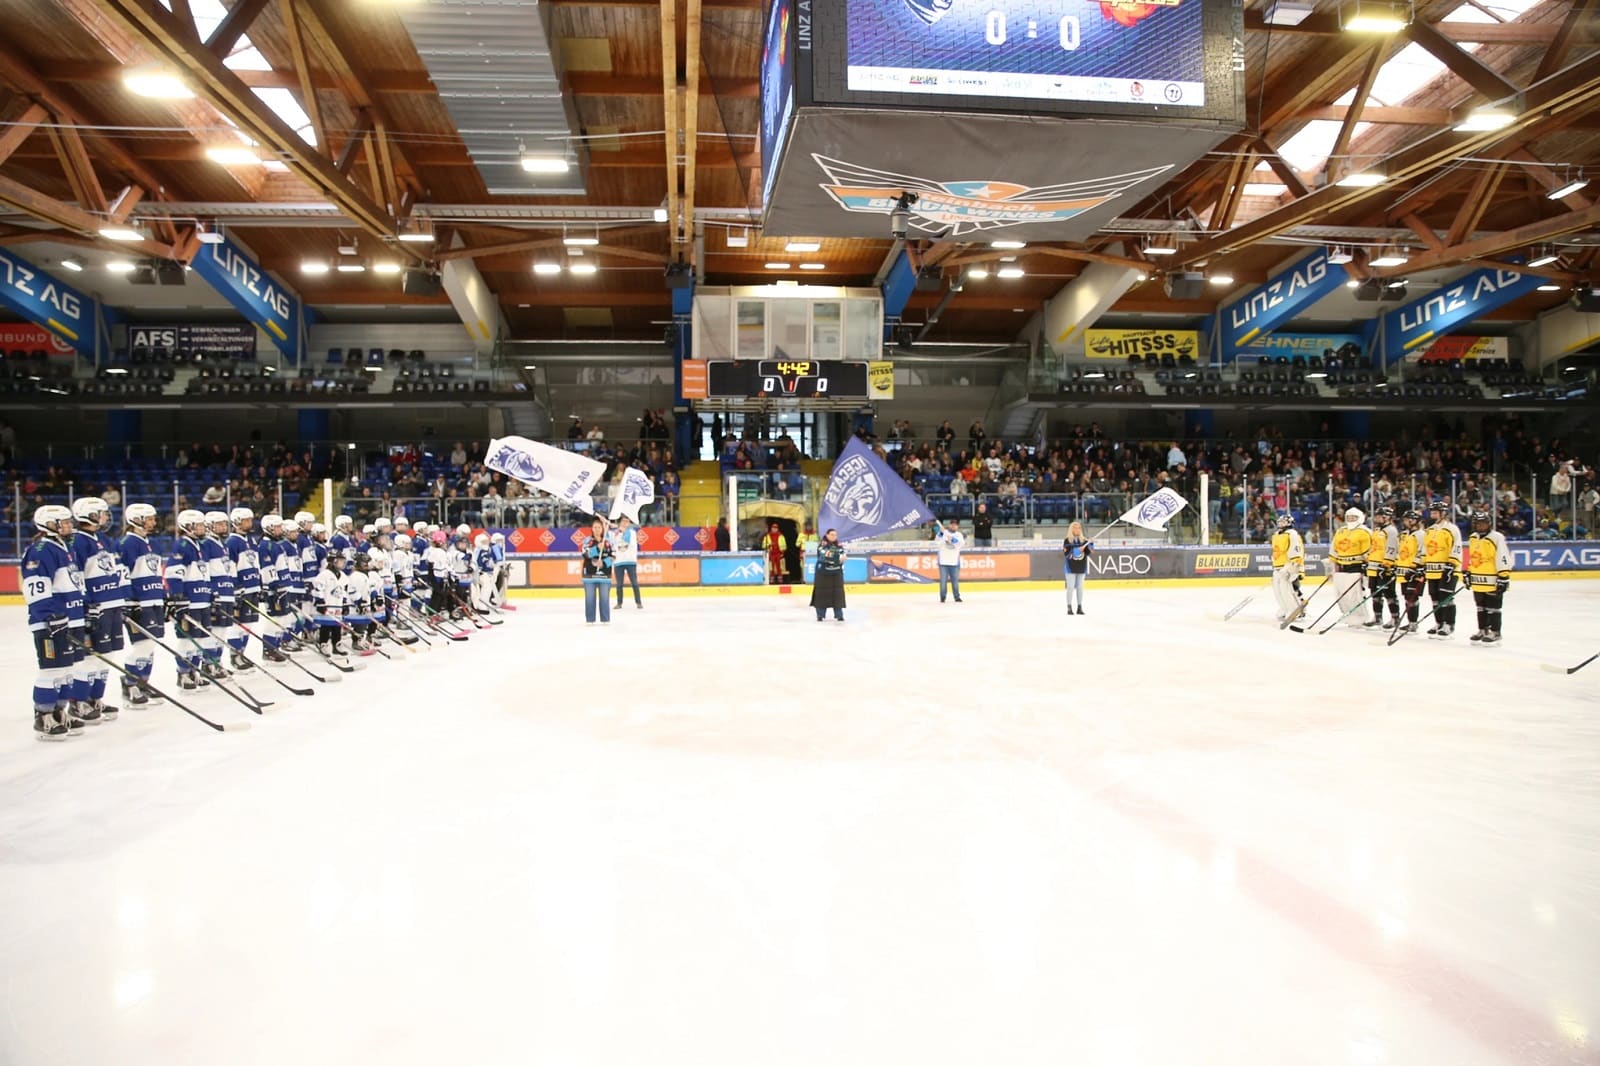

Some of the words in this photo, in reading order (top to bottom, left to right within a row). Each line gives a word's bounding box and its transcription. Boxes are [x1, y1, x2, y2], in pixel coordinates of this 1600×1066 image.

[798, 15, 811, 50] LINZ
[986, 10, 1006, 45] 0
[1061, 16, 1080, 50] 0
[966, 207, 1056, 219] WINGS
[213, 243, 261, 297] LINZ
[263, 284, 290, 320] AG
[1232, 281, 1284, 329] LINZ
[1288, 255, 1327, 297] AG
[40, 284, 81, 320] AG
[1400, 285, 1467, 332] LINZ
[1472, 269, 1520, 301] AG
[0, 333, 48, 343] BUND
[134, 331, 175, 347] AFS
[1109, 334, 1175, 356] HITSSS
[777, 362, 810, 375] 4:42
[763, 378, 774, 392] 0
[816, 378, 828, 392] 0
[922, 556, 995, 569] Stbach
[1086, 554, 1151, 575] NABO
[1501, 555, 1507, 565] 4
[1511, 549, 1552, 566] NZ
[1557, 548, 1600, 565] AG
[28, 581, 45, 596] 79
[92, 582, 118, 592] LINZ
